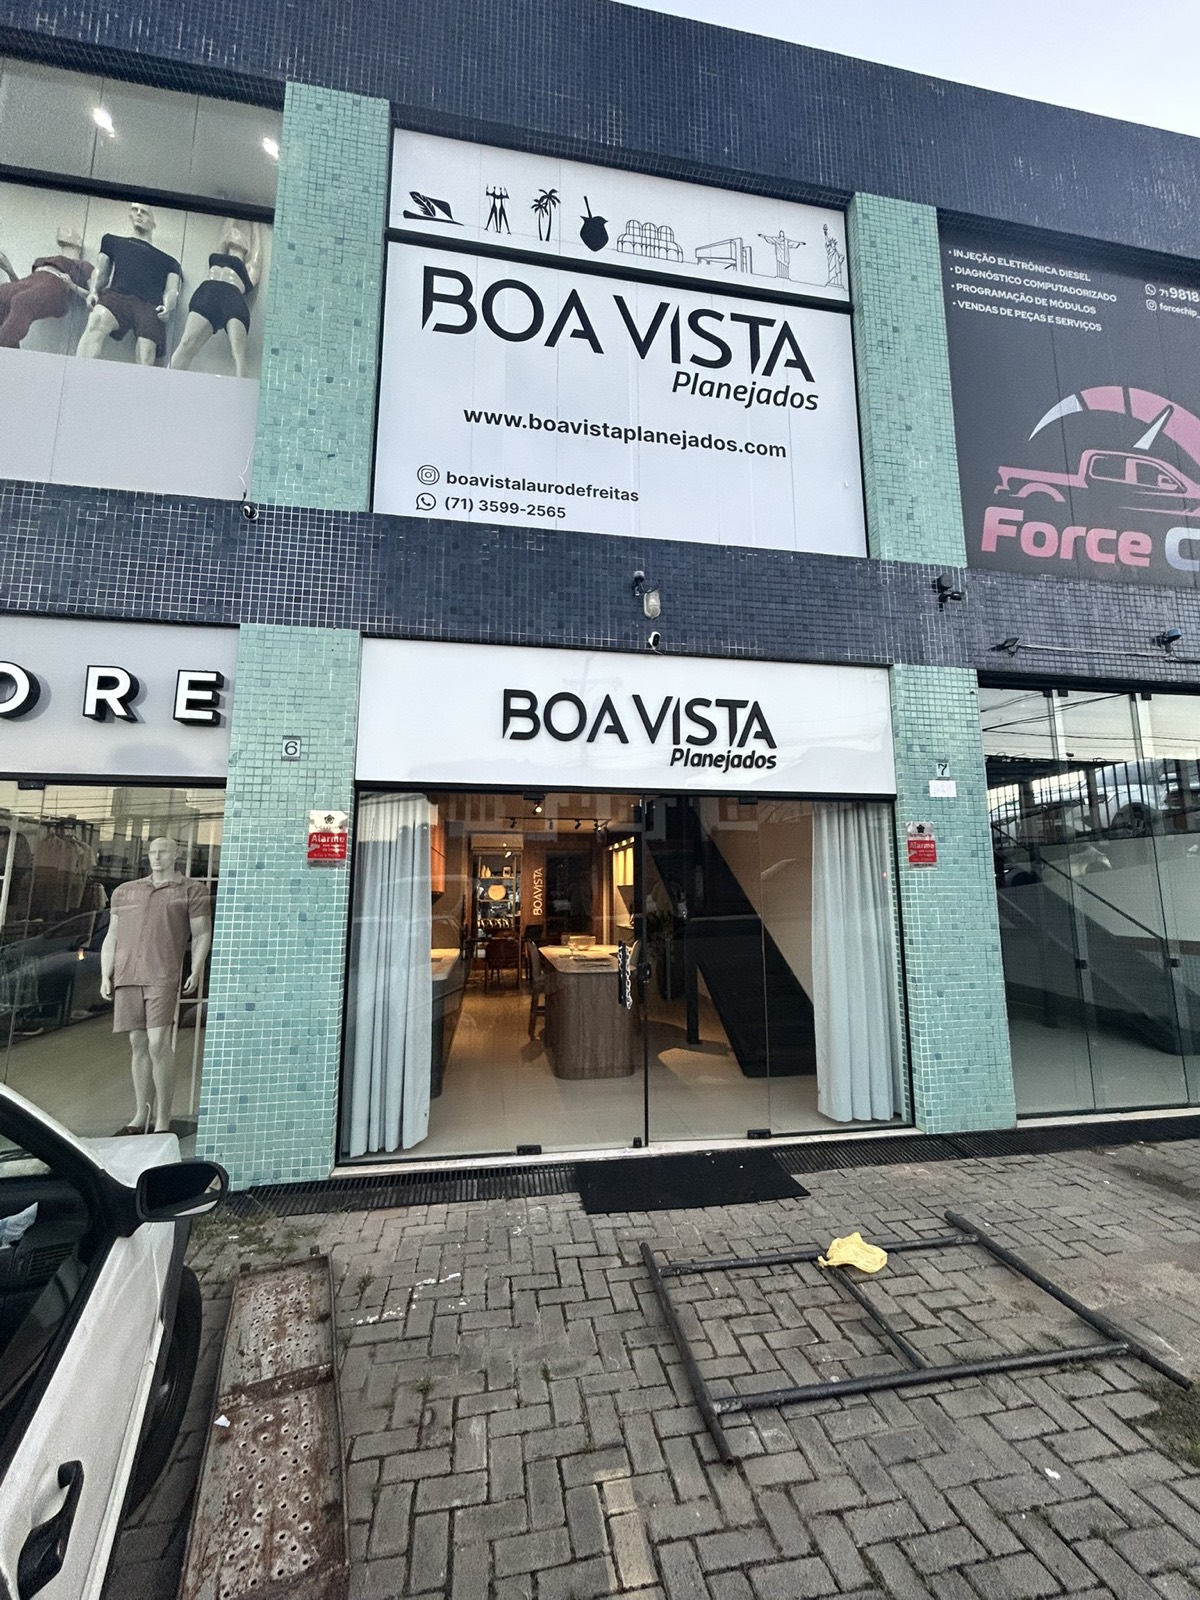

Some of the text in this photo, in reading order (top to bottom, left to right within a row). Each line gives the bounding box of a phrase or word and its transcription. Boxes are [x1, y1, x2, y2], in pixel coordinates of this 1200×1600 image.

[953, 248, 1092, 282] INJEÇÃO ELETRÔNICA DIESEL
[954, 265, 1117, 302] DIAGNÓSTICO COMPUTADORIZADO
[956, 283, 1097, 315] PROGRAMAÇÃO DE MÓDULOS
[957, 300, 1102, 331] VENDAS DE PEÇAS E SERVIÇOS
[672, 370, 819, 411] Planejados
[463, 408, 787, 459] www.boavistaplanejados.com
[446, 471, 640, 502] boavistalaurodefreitas
[444, 496, 567, 519] (71) 3599-2565
[980, 506, 1153, 568] Force
[284, 740, 299, 756] 6
[669, 748, 777, 773] Planejados
[937, 763, 948, 776] 7
[311, 834, 346, 843] Alarme
[909, 841, 935, 850] Alarme
